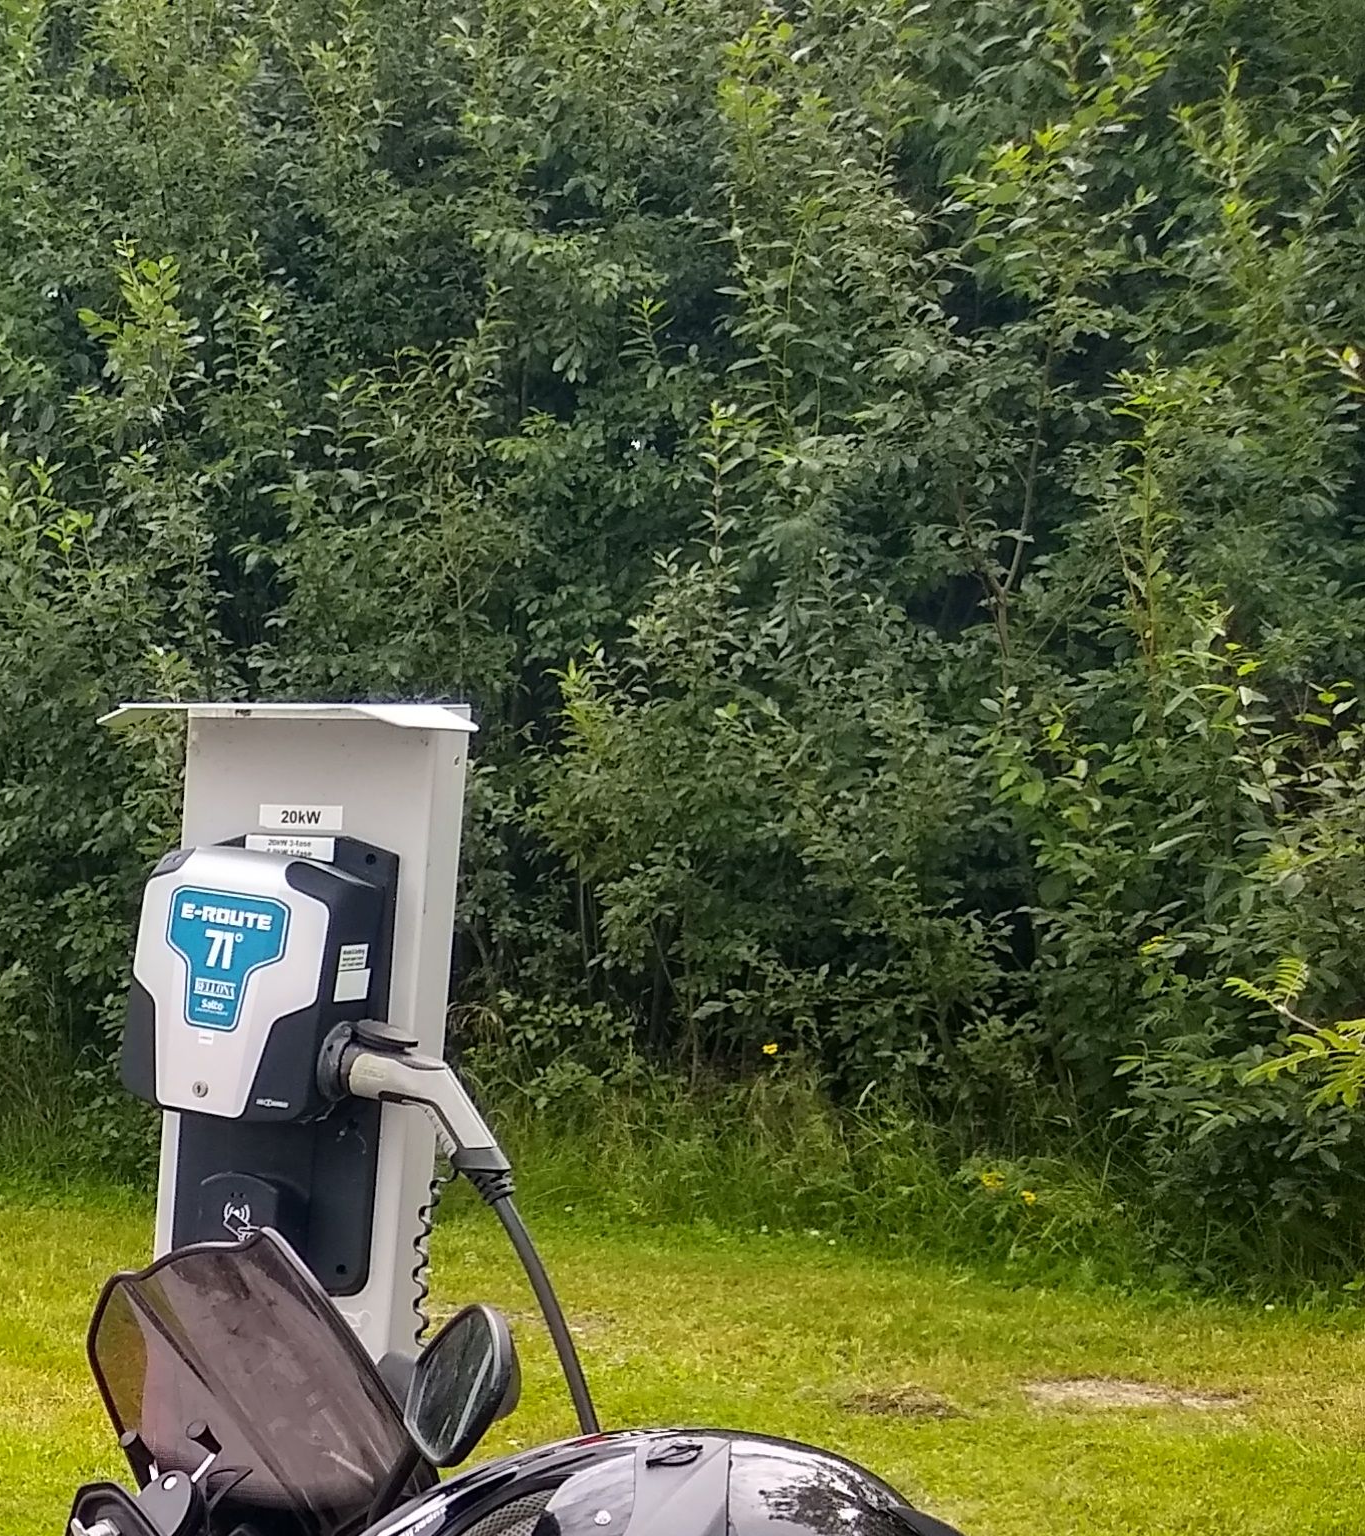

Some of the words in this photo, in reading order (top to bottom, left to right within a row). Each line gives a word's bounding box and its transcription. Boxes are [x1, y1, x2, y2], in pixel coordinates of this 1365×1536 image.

[280, 810, 322, 825] 20kW
[268, 839, 288, 847] 20kW
[180, 902, 273, 931] E-ROUTE
[205, 928, 244, 970] 71°
